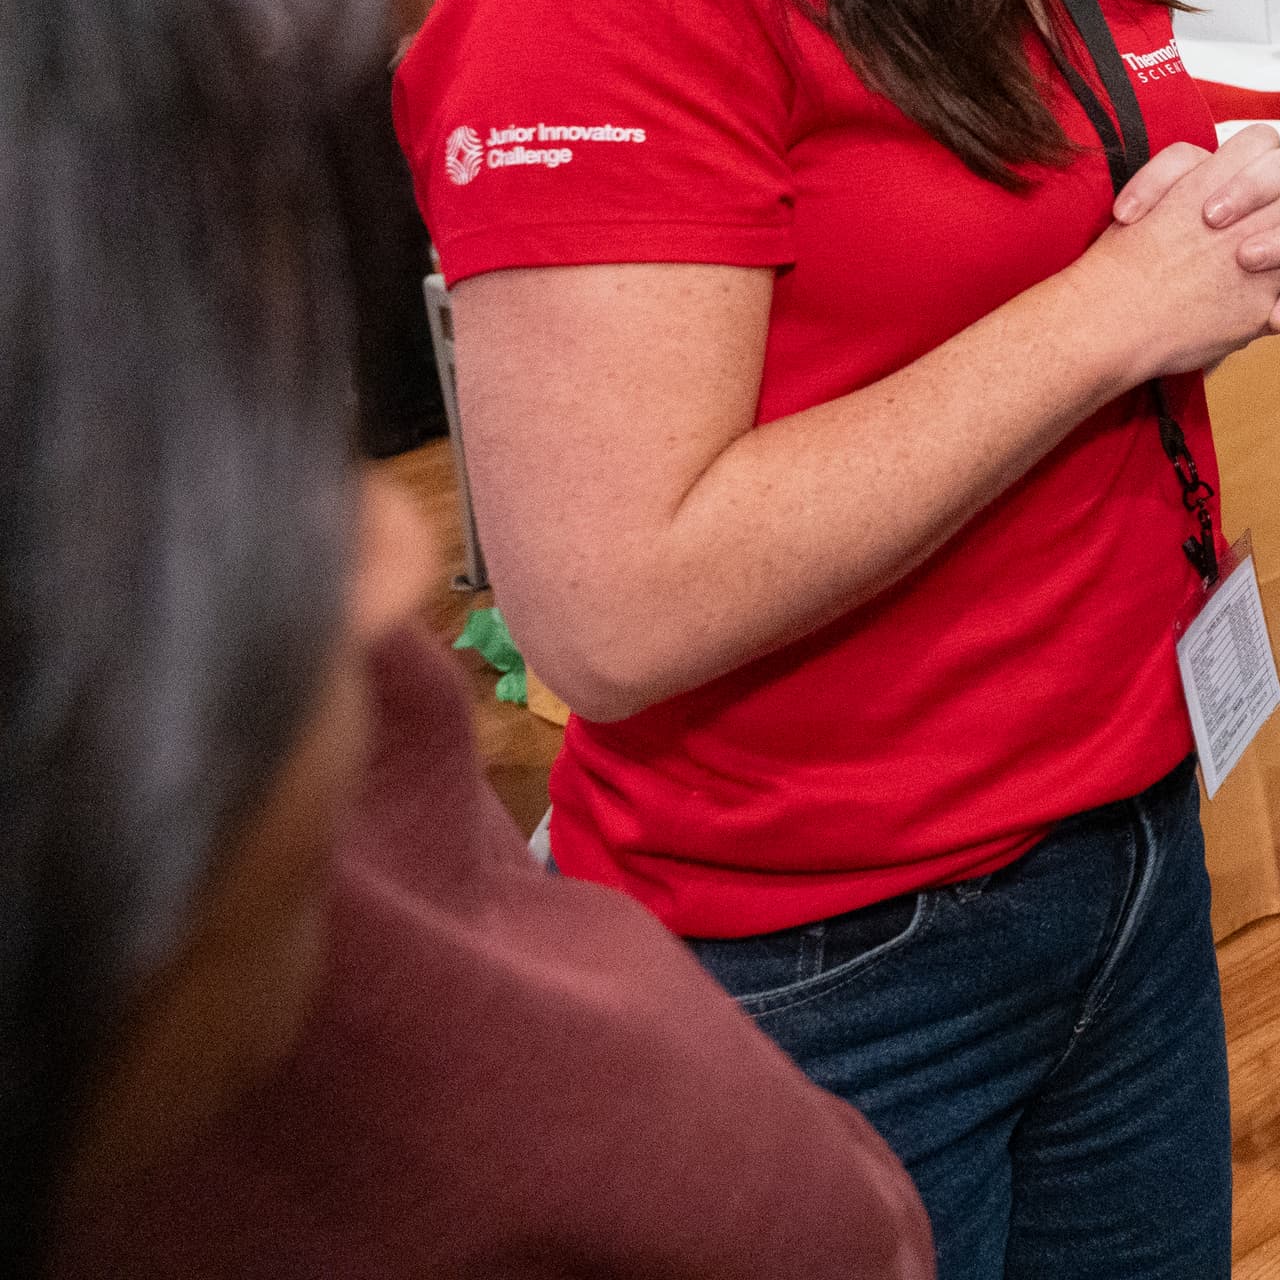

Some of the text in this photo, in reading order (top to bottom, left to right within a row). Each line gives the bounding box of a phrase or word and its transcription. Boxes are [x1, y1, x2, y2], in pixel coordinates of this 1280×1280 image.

[486, 123, 646, 146] Junior Innovators
[487, 146, 573, 168] Challenge
